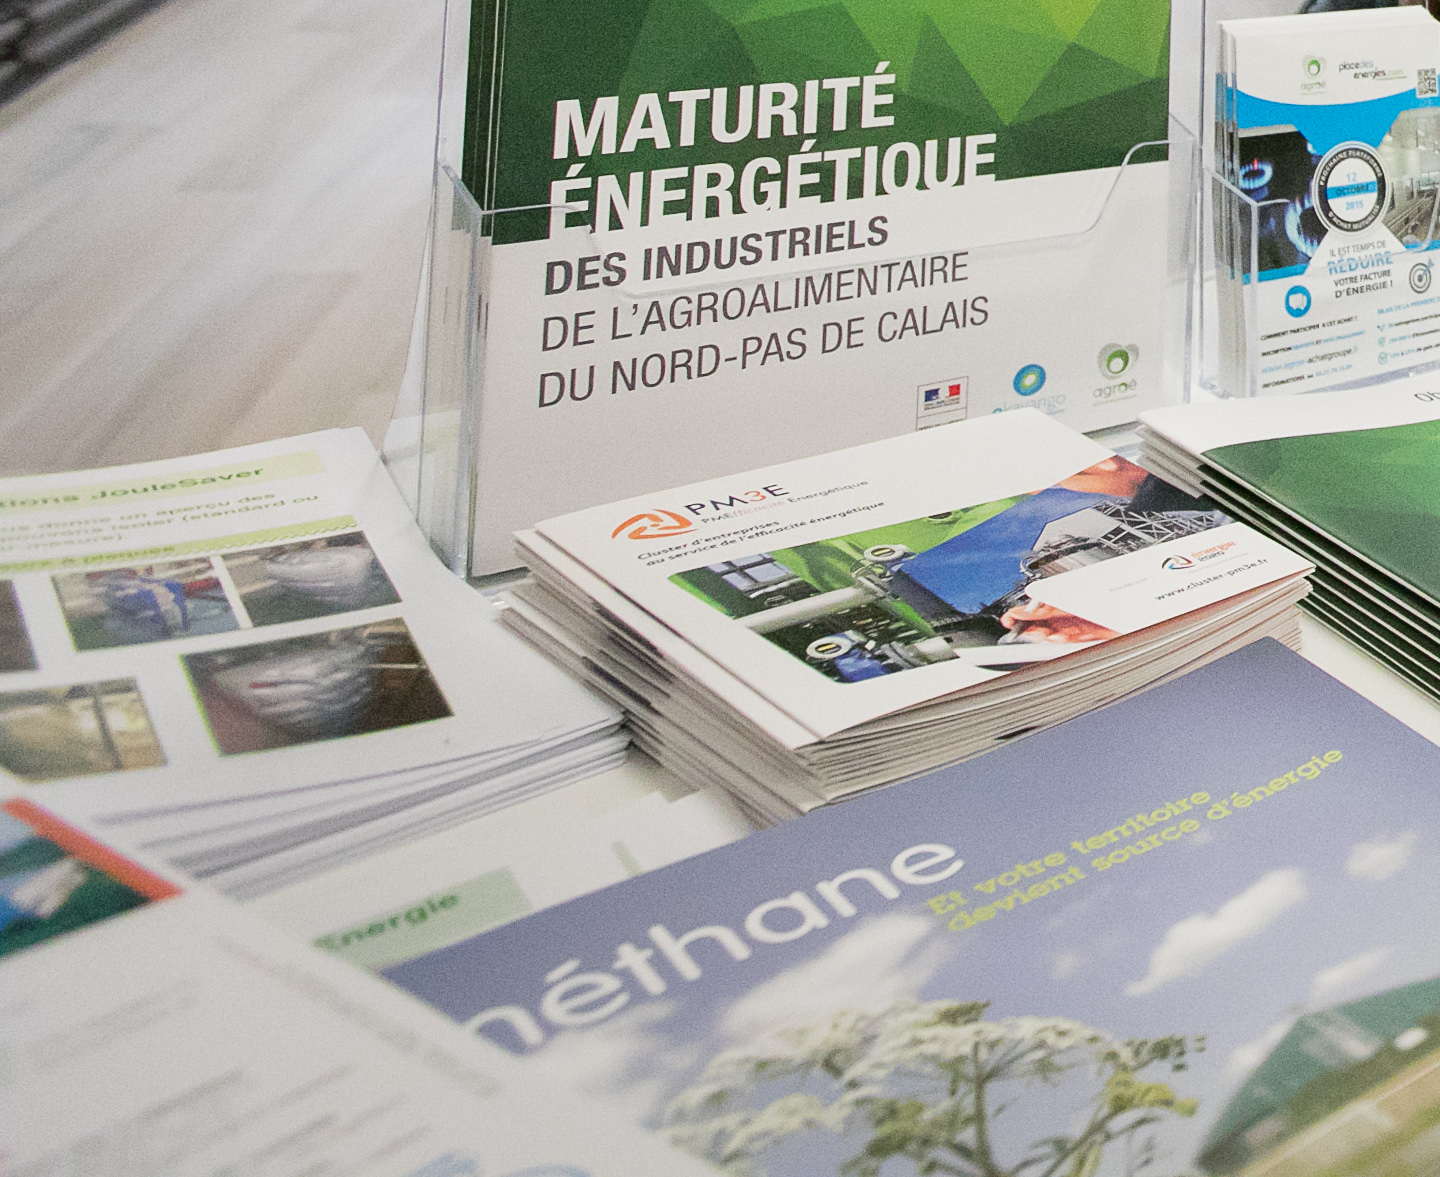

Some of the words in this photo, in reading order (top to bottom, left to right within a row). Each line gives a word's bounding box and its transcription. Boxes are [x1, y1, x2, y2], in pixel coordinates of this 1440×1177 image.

[551, 61, 896, 160] MATURITÉ
[549, 134, 997, 239] ÉNERGÉTIQUE
[1346, 172, 1357, 182] 12
[544, 252, 627, 296] DES
[642, 215, 889, 281] INDUSTRIELS
[1327, 250, 1393, 275] RÉDUIRE
[1329, 249, 1336, 257] IL
[1338, 246, 1350, 256] EST
[1352, 241, 1375, 253] TEMPS
[1377, 240, 1386, 249] DE
[1333, 275, 1358, 287] VOTRE
[1359, 269, 1391, 282] FACTURE
[538, 365, 595, 408] DU
[611, 327, 807, 395] NORD-PAS
[821, 316, 865, 355] DE
[877, 296, 989, 343] CALAIS
[541, 311, 595, 352] DE
[92, 467, 263, 501] JouleSaver
[684, 484, 790, 516] PM3E
[637, 542, 688, 561] Cluster
[646, 559, 666, 567] au
[668, 544, 717, 562] service
[720, 537, 737, 547] de
[809, 501, 885, 525] énergétique
[1154, 557, 1268, 602] www.cluster-pm3e.fr
[927, 890, 968, 916] Et
[973, 850, 1067, 894] votre
[1071, 790, 1211, 855] territoire
[947, 865, 1087, 931] devient
[1091, 818, 1200, 872] source
